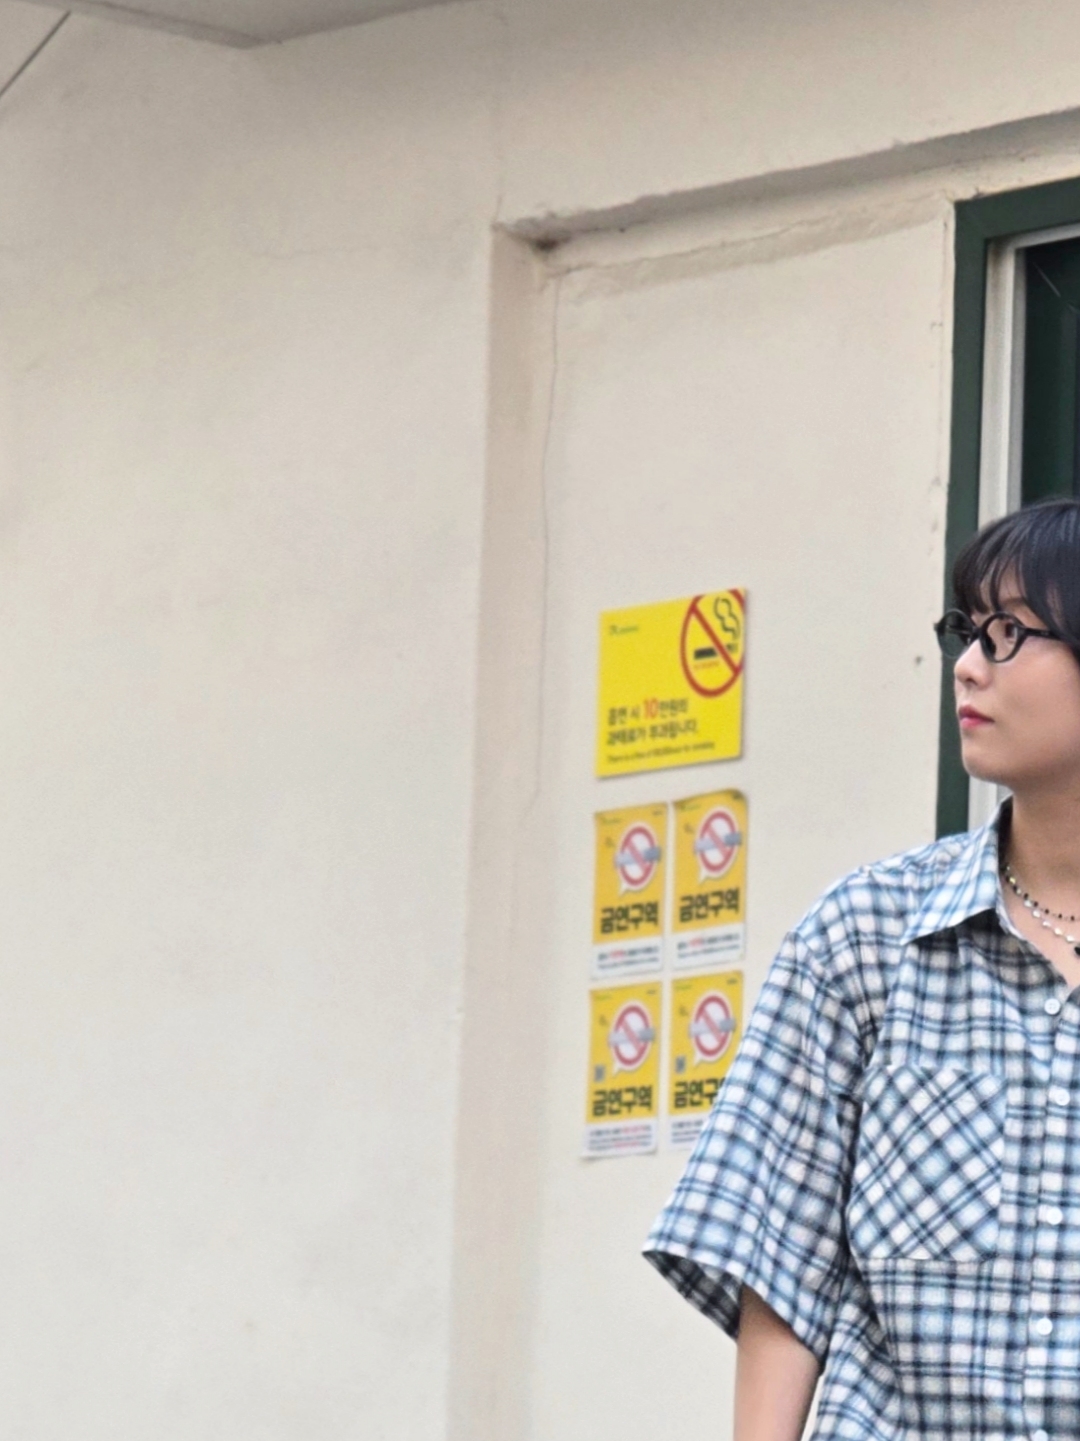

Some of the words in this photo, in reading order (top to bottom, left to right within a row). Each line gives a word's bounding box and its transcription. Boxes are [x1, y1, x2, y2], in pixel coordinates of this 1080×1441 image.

[600, 902, 658, 934] 금연구역
[679, 888, 739, 923] 금연구역
[593, 1085, 652, 1116] 금연구역
[675, 1078, 725, 1108] 금연구
